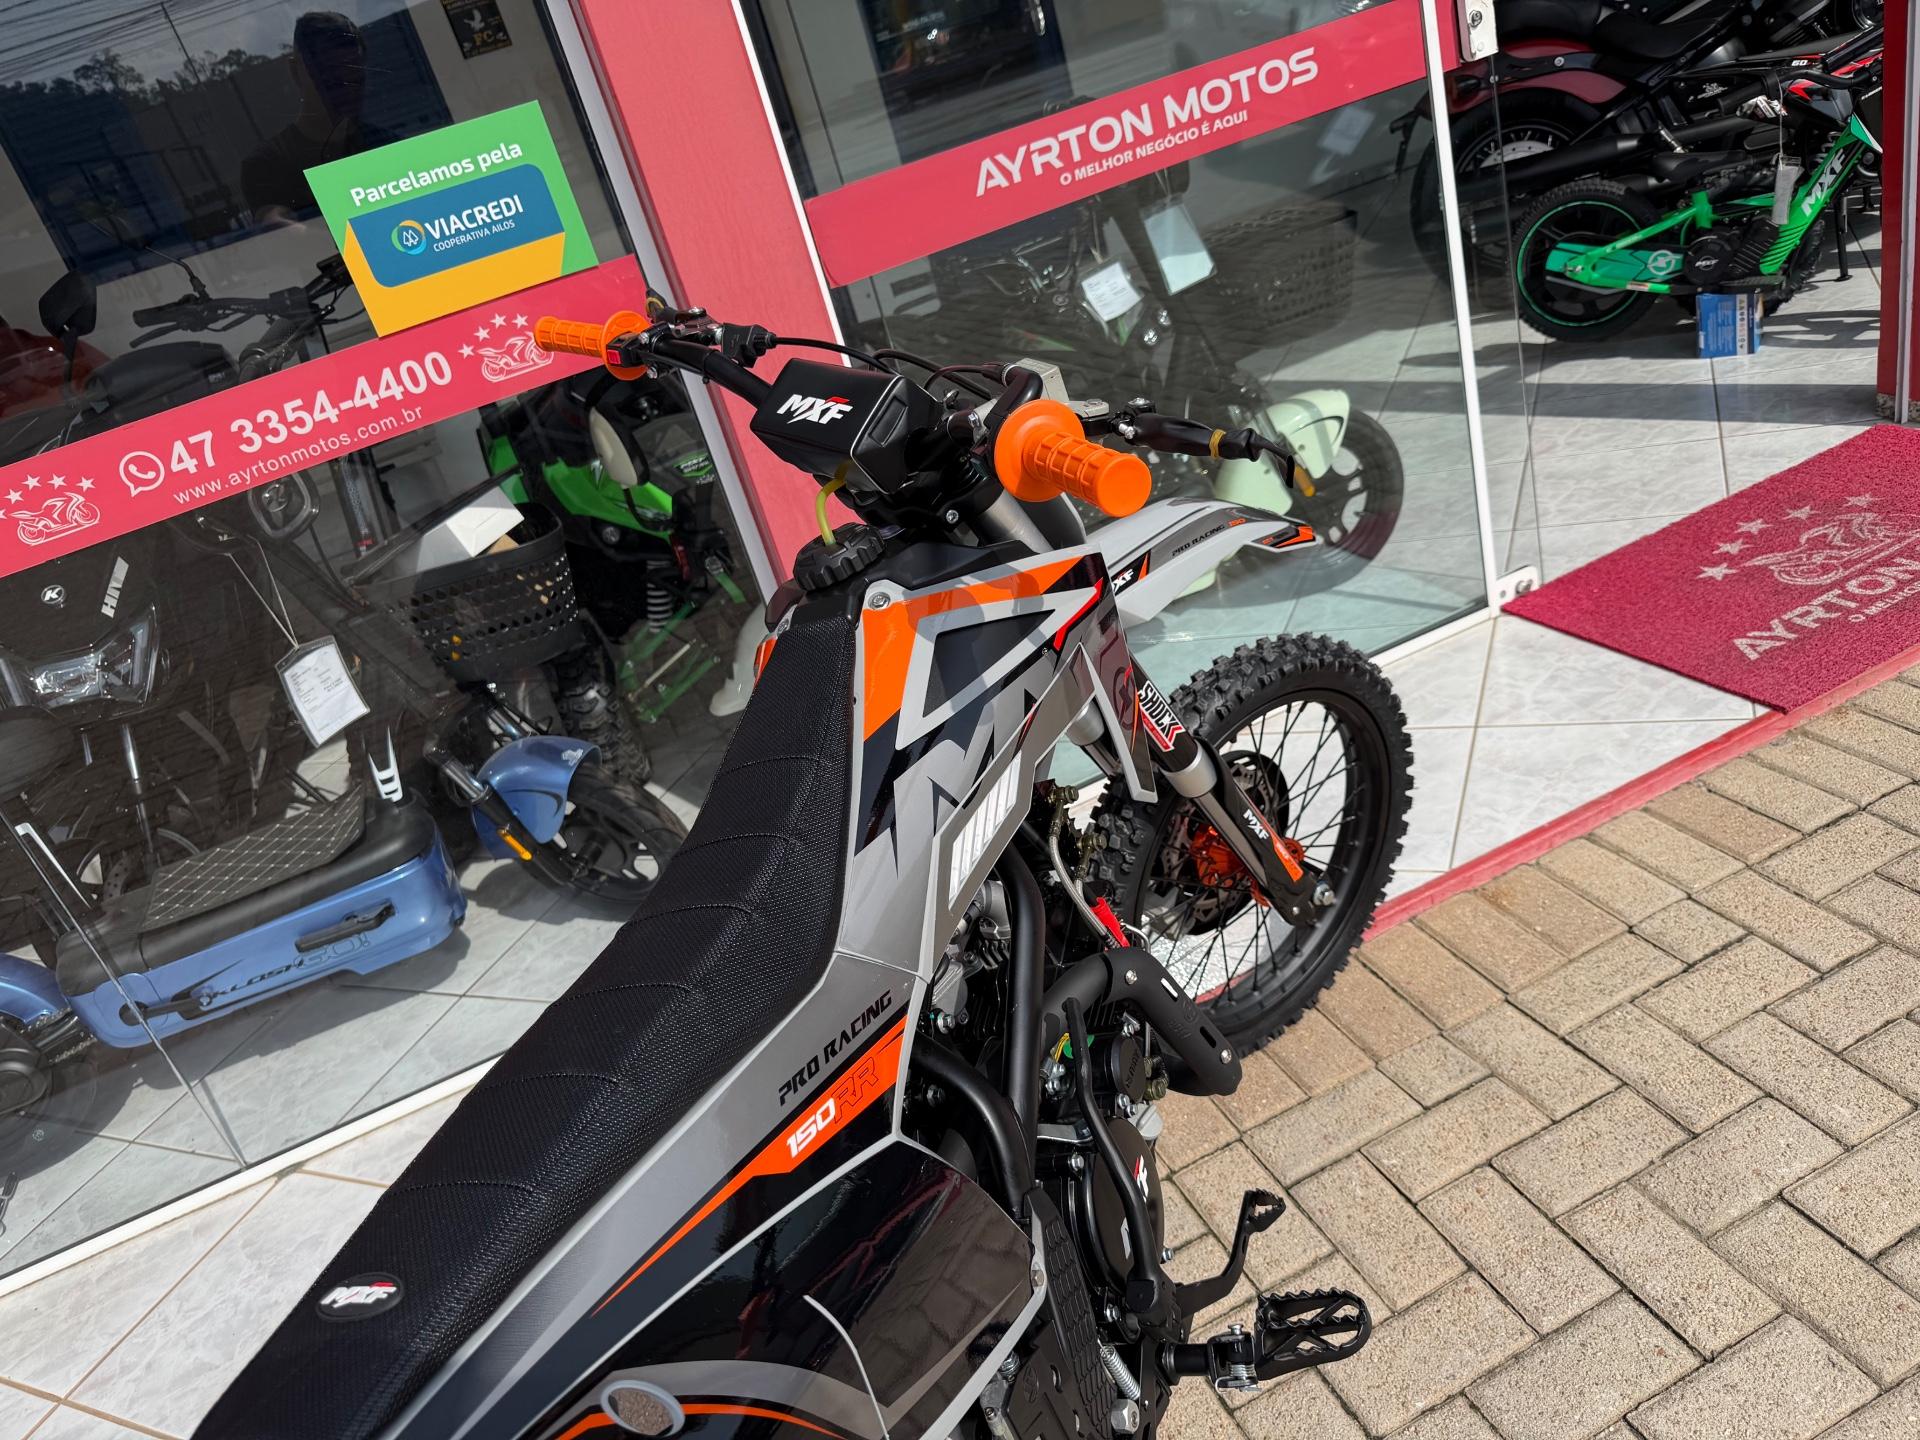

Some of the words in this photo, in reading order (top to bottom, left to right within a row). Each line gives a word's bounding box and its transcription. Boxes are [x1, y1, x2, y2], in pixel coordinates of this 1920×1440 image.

[975, 103, 1154, 197] AYRTON
[1162, 46, 1319, 129] MOTOS
[1059, 173, 1073, 187] O
[1074, 150, 1134, 182] MELHOR
[1135, 126, 1200, 159] NEGÓCIO
[1200, 120, 1212, 137] É
[1212, 109, 1248, 133] AQUI
[350, 156, 476, 208] Parcelamos
[476, 142, 523, 173] pela
[1800, 147, 1847, 217] MXF
[424, 194, 524, 240] VIACREDI
[433, 226, 491, 252] COOPERATIVA
[492, 219, 516, 234] AILOS
[169, 429, 217, 475] 47
[230, 351, 453, 454] 3354-4400
[776, 393, 854, 425] MXF
[173, 405, 424, 505] www.ayrtonmotos.com.br
[1171, 540, 1191, 557] PRO
[1192, 523, 1226, 544] RACING
[1732, 555, 1920, 661] AYRTON
[1242, 808, 1270, 841] MXF
[778, 1054, 820, 1108] PRO
[823, 988, 893, 1065] RACING
[319, 1281, 397, 1309] MXF
